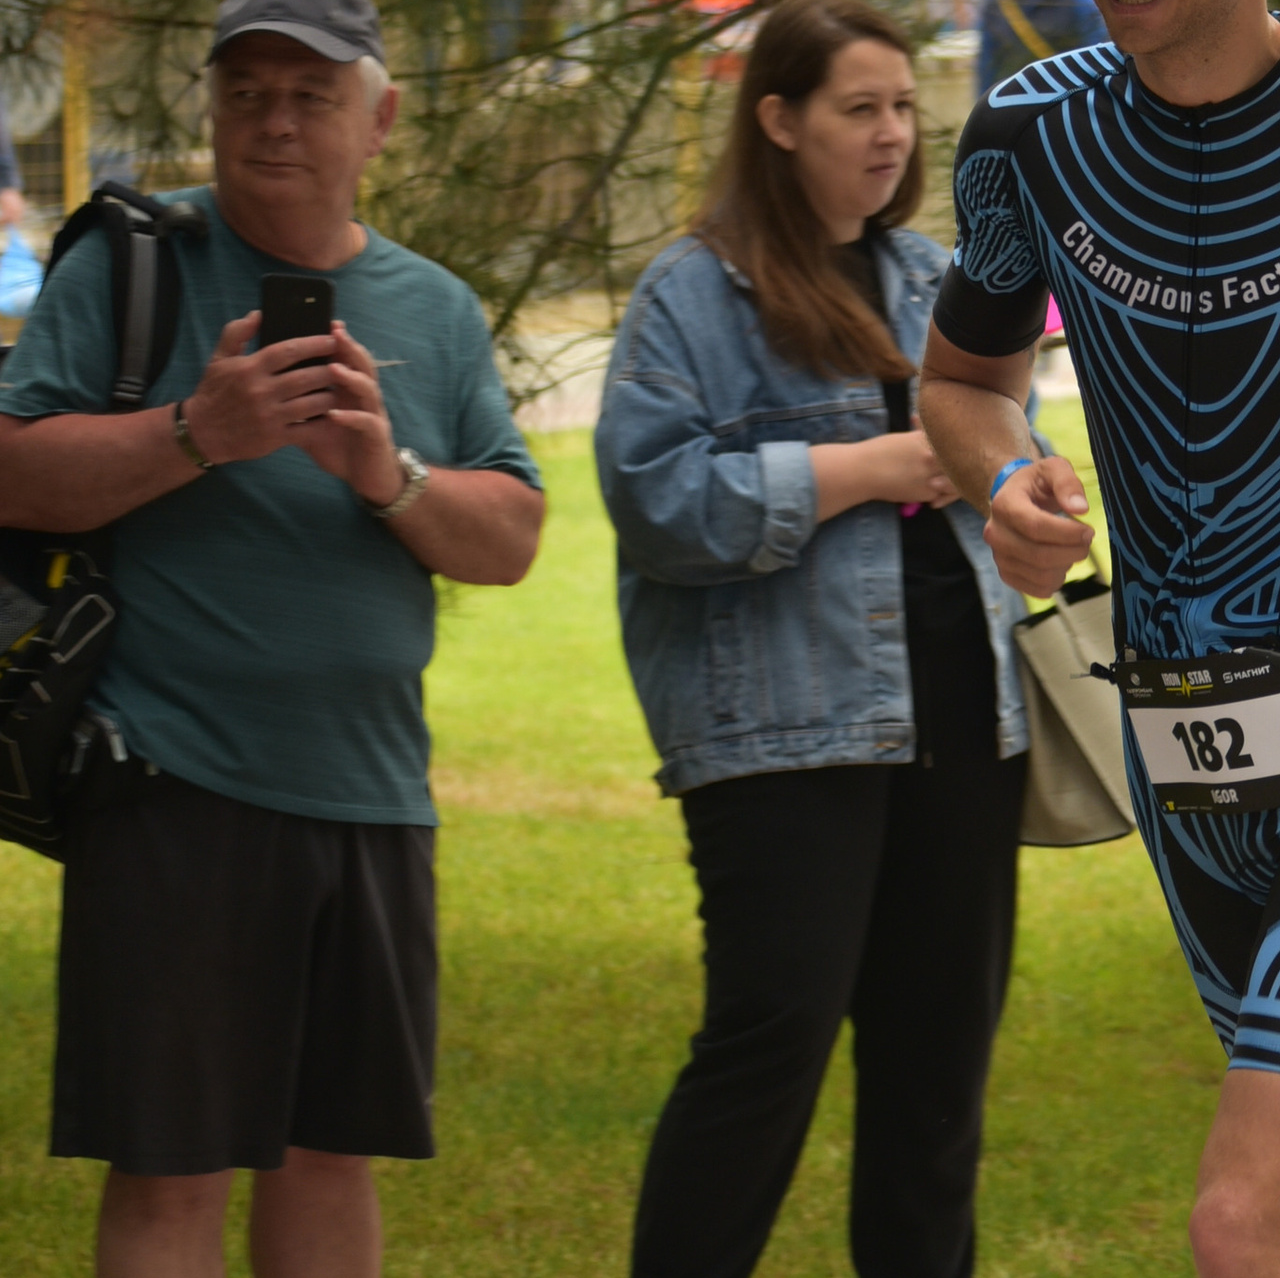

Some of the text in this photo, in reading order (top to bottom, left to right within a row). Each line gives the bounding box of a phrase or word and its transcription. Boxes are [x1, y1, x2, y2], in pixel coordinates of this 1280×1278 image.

[1062, 220, 1213, 314] Champions
[1161, 669, 1213, 687] IRON STAR
[1233, 664, 1271, 681] МАГНИТ
[1171, 717, 1255, 773] 182
[1210, 788, 1239, 804] IGOR
